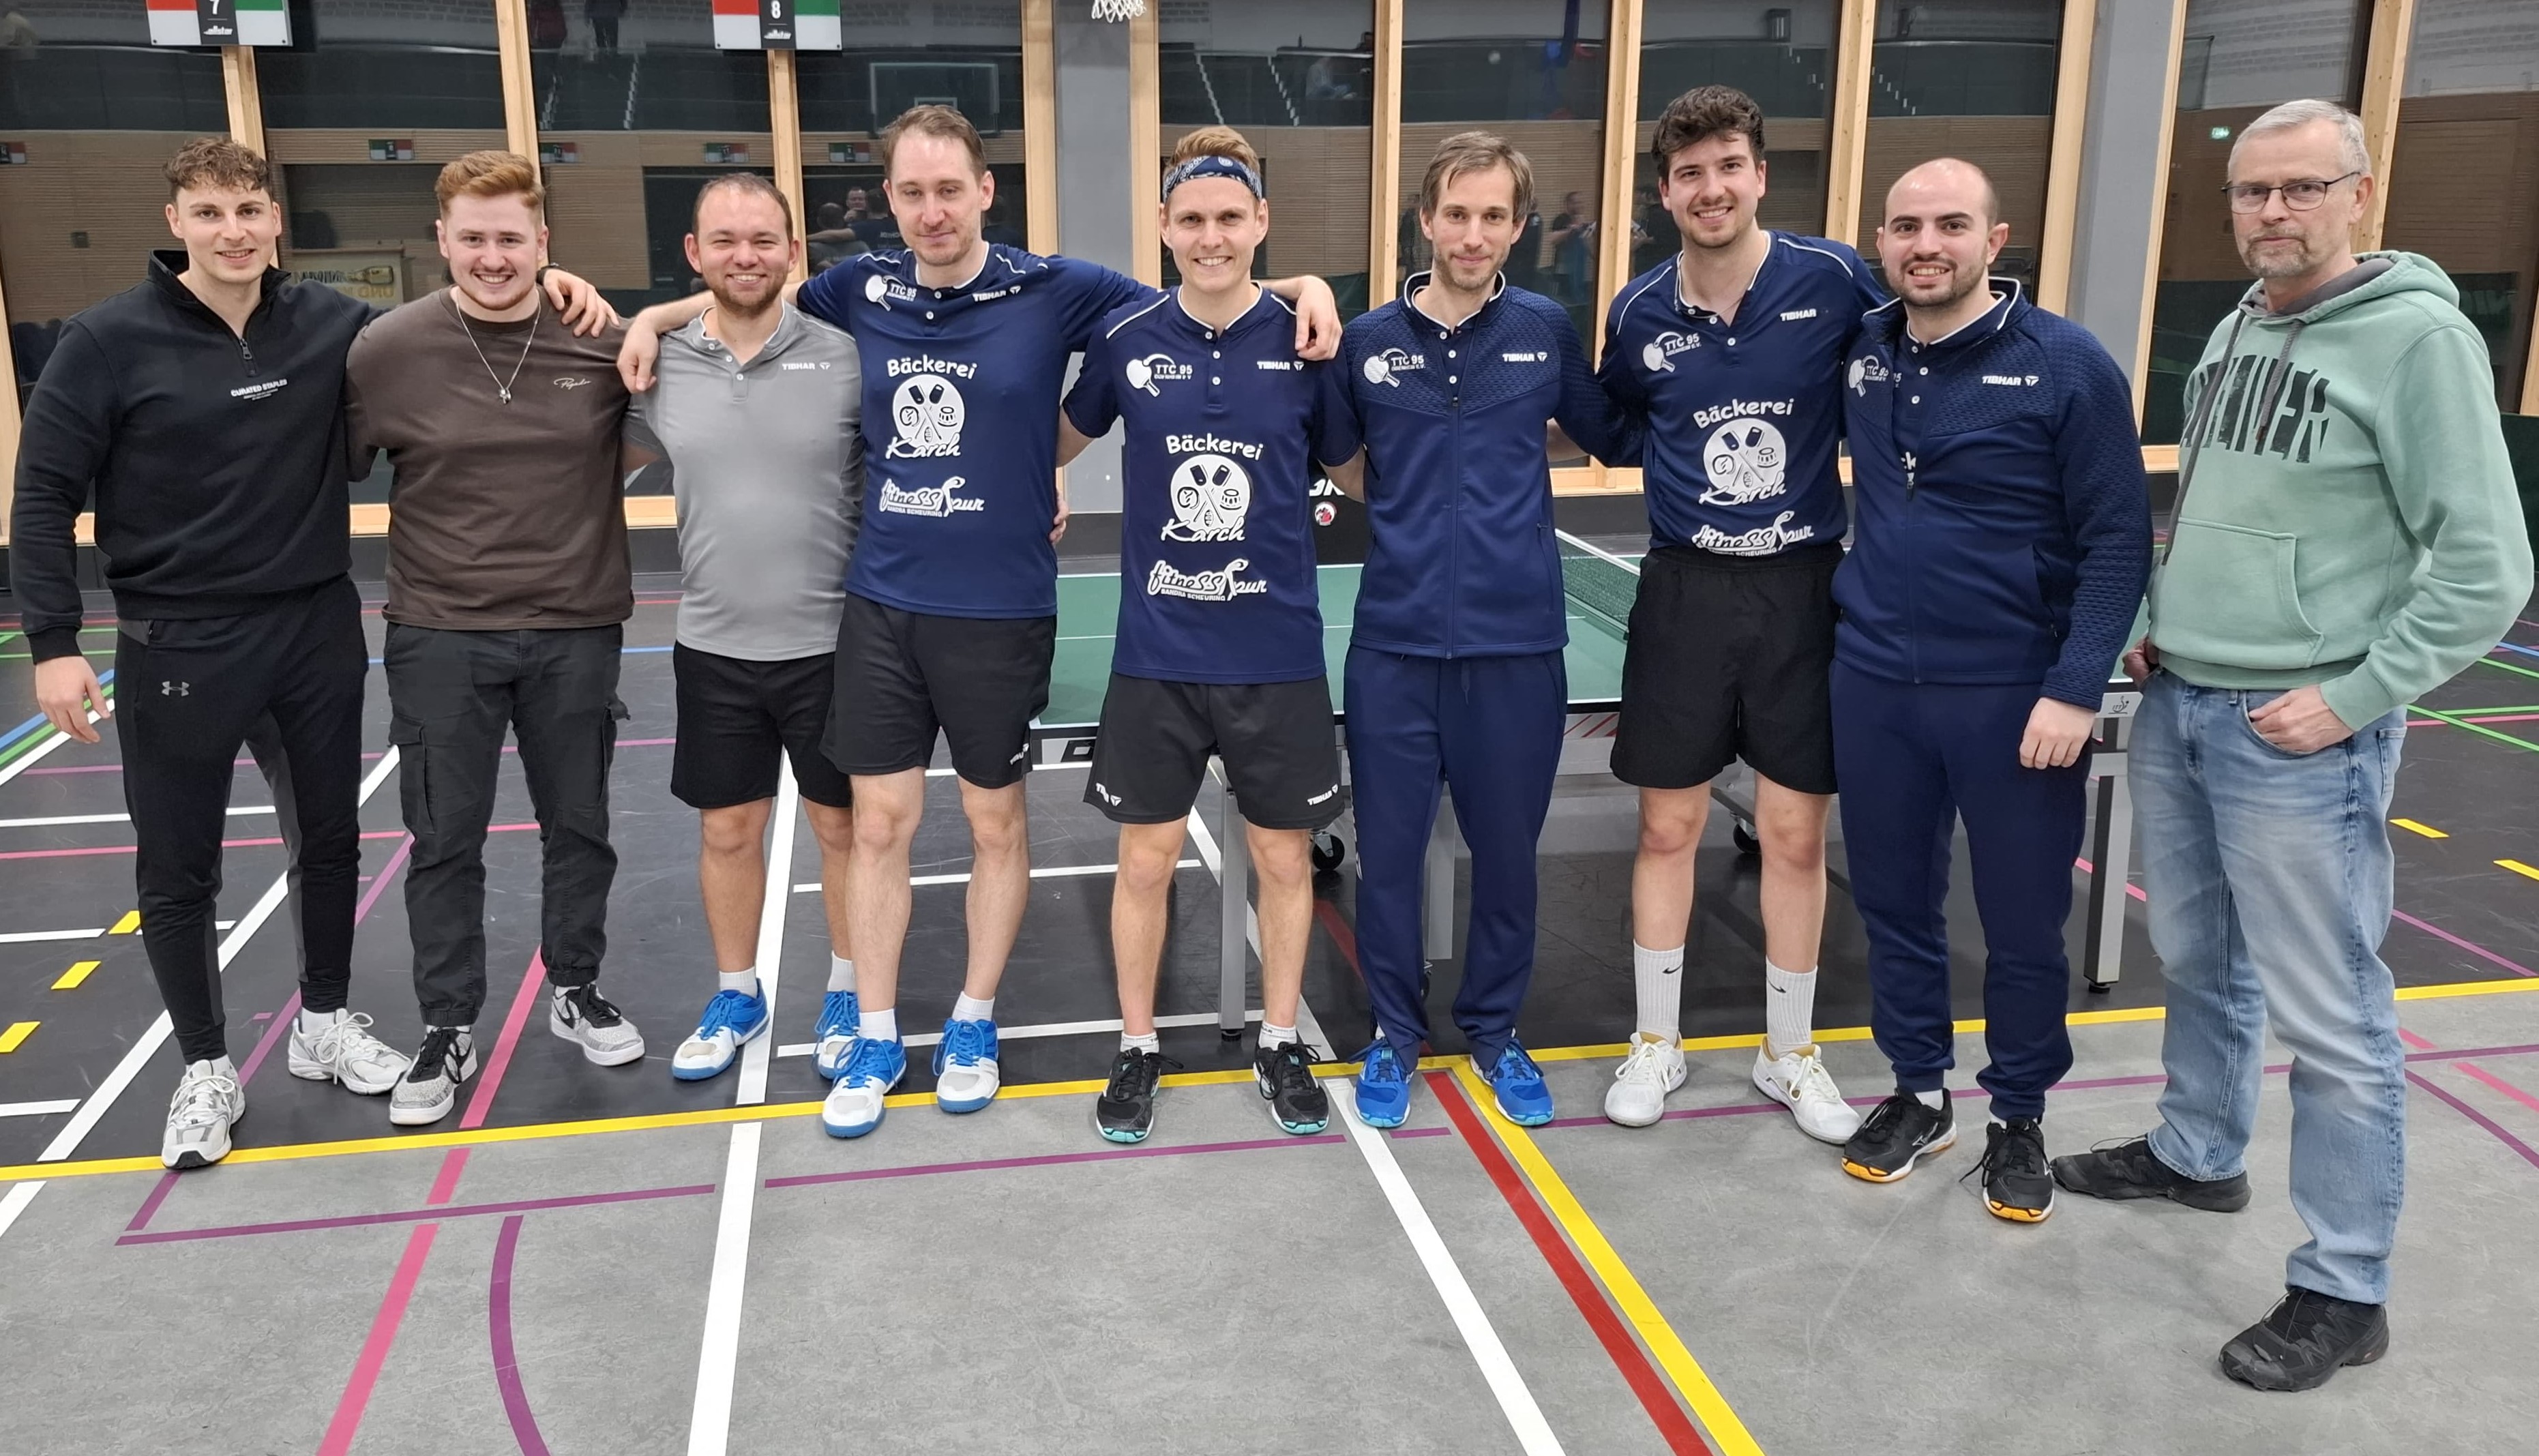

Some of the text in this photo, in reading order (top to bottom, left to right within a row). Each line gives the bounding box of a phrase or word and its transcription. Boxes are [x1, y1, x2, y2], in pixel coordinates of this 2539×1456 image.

[209, 0, 220, 14] 7
[771, 0, 781, 18] 8
[891, 282, 907, 295] TTC
[972, 290, 1007, 302] TIBHAR
[1780, 308, 1817, 322] TIBHAR
[1664, 333, 1699, 352] TTC 95
[1391, 355, 1425, 366] TTC 95
[1502, 353, 1535, 362] TIBHAR
[887, 354, 978, 380] Bäckerei
[1155, 363, 1193, 375] TTC 95
[1256, 360, 1290, 370] TIBHAR
[1982, 375, 2022, 386] TIBHAR
[231, 385, 263, 397] CURATED
[1693, 398, 1794, 429] Bäckerei
[885, 432, 961, 460] Karch
[1165, 432, 1263, 460] Bäckerei
[1699, 471, 1787, 506] Karch
[1161, 516, 1245, 542] Karch
[1161, 588, 1226, 602] SANDRA SCHEURING
